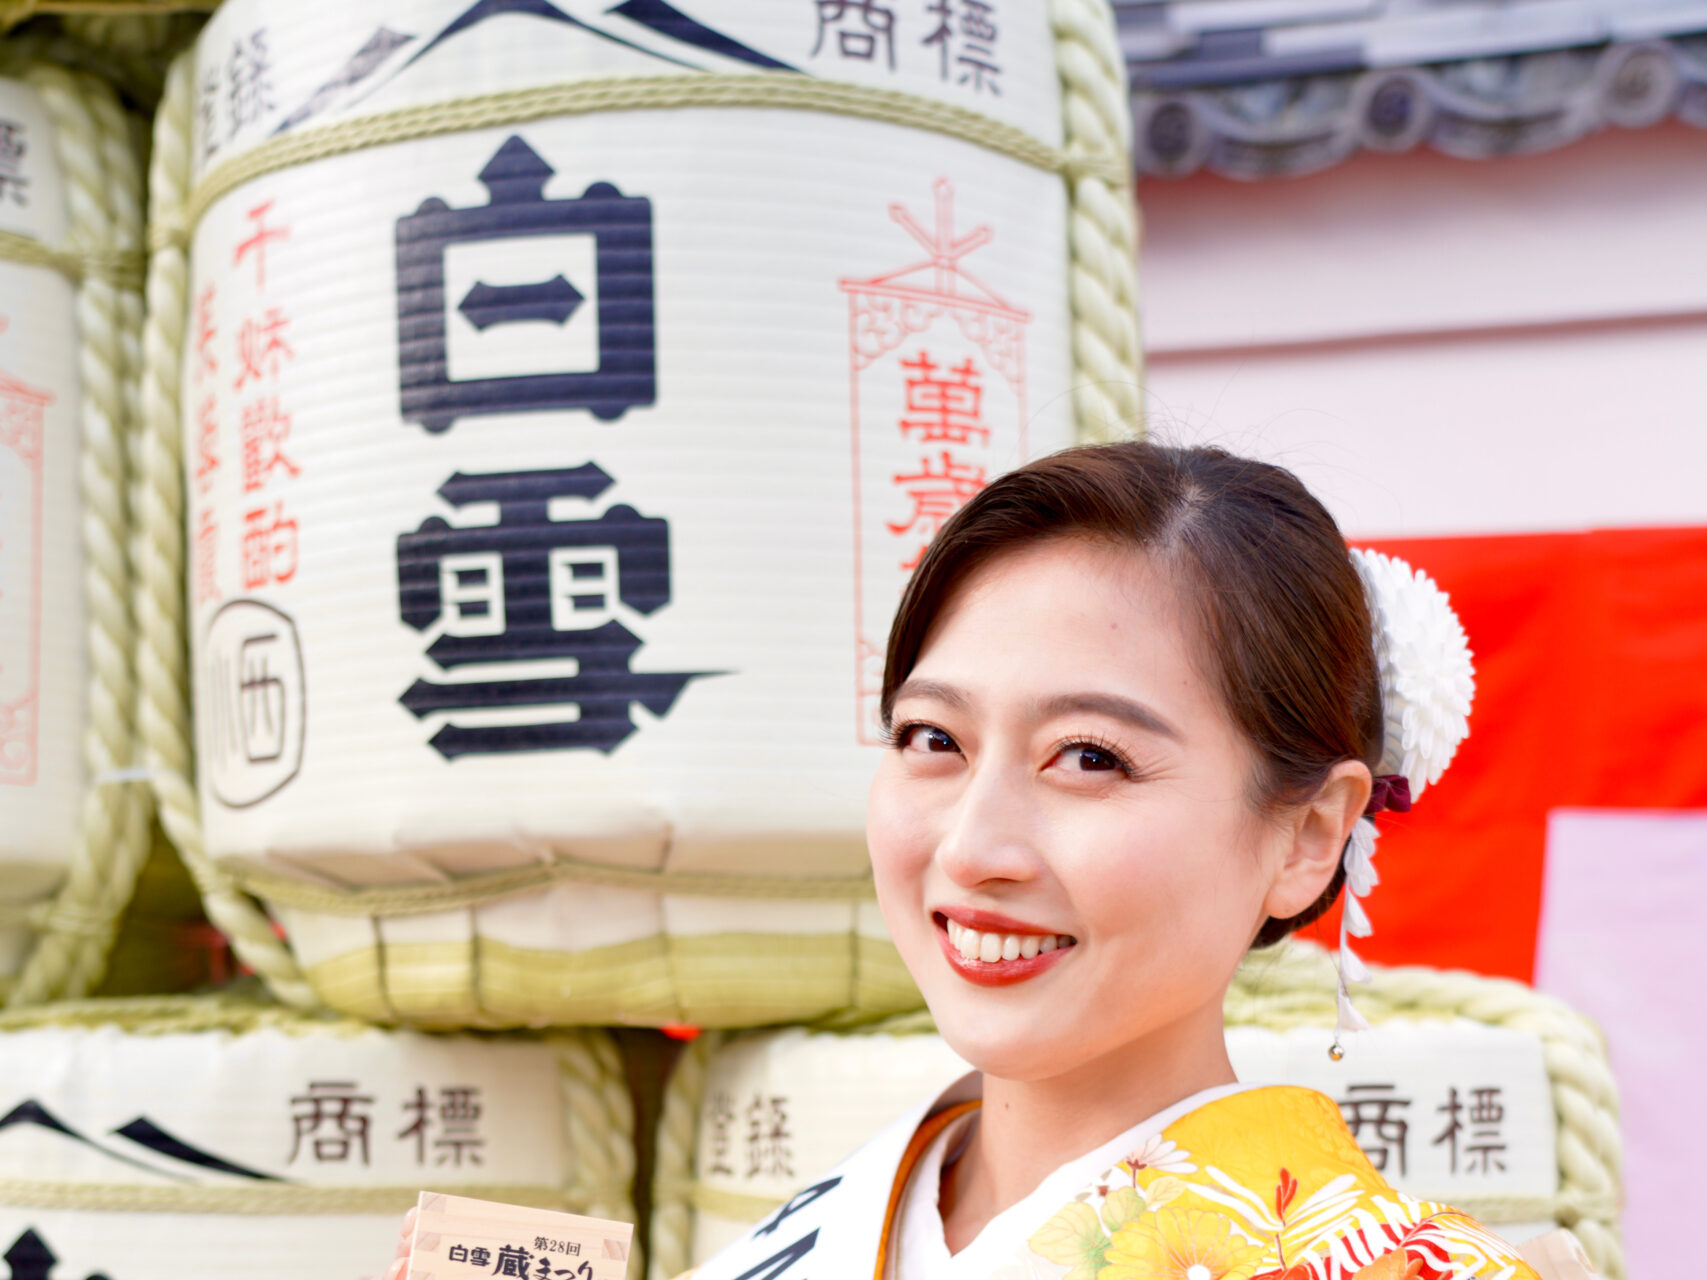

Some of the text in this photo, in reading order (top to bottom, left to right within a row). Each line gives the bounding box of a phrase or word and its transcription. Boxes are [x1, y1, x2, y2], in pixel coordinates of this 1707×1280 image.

[810, 0, 1003, 96] 商標
[395, 135, 732, 760] 白雪
[887, 351, 990, 571] 萬歳
[287, 1081, 487, 1168] 商標
[1341, 1084, 1508, 1177] 商標
[533, 1235, 582, 1257] 第28回
